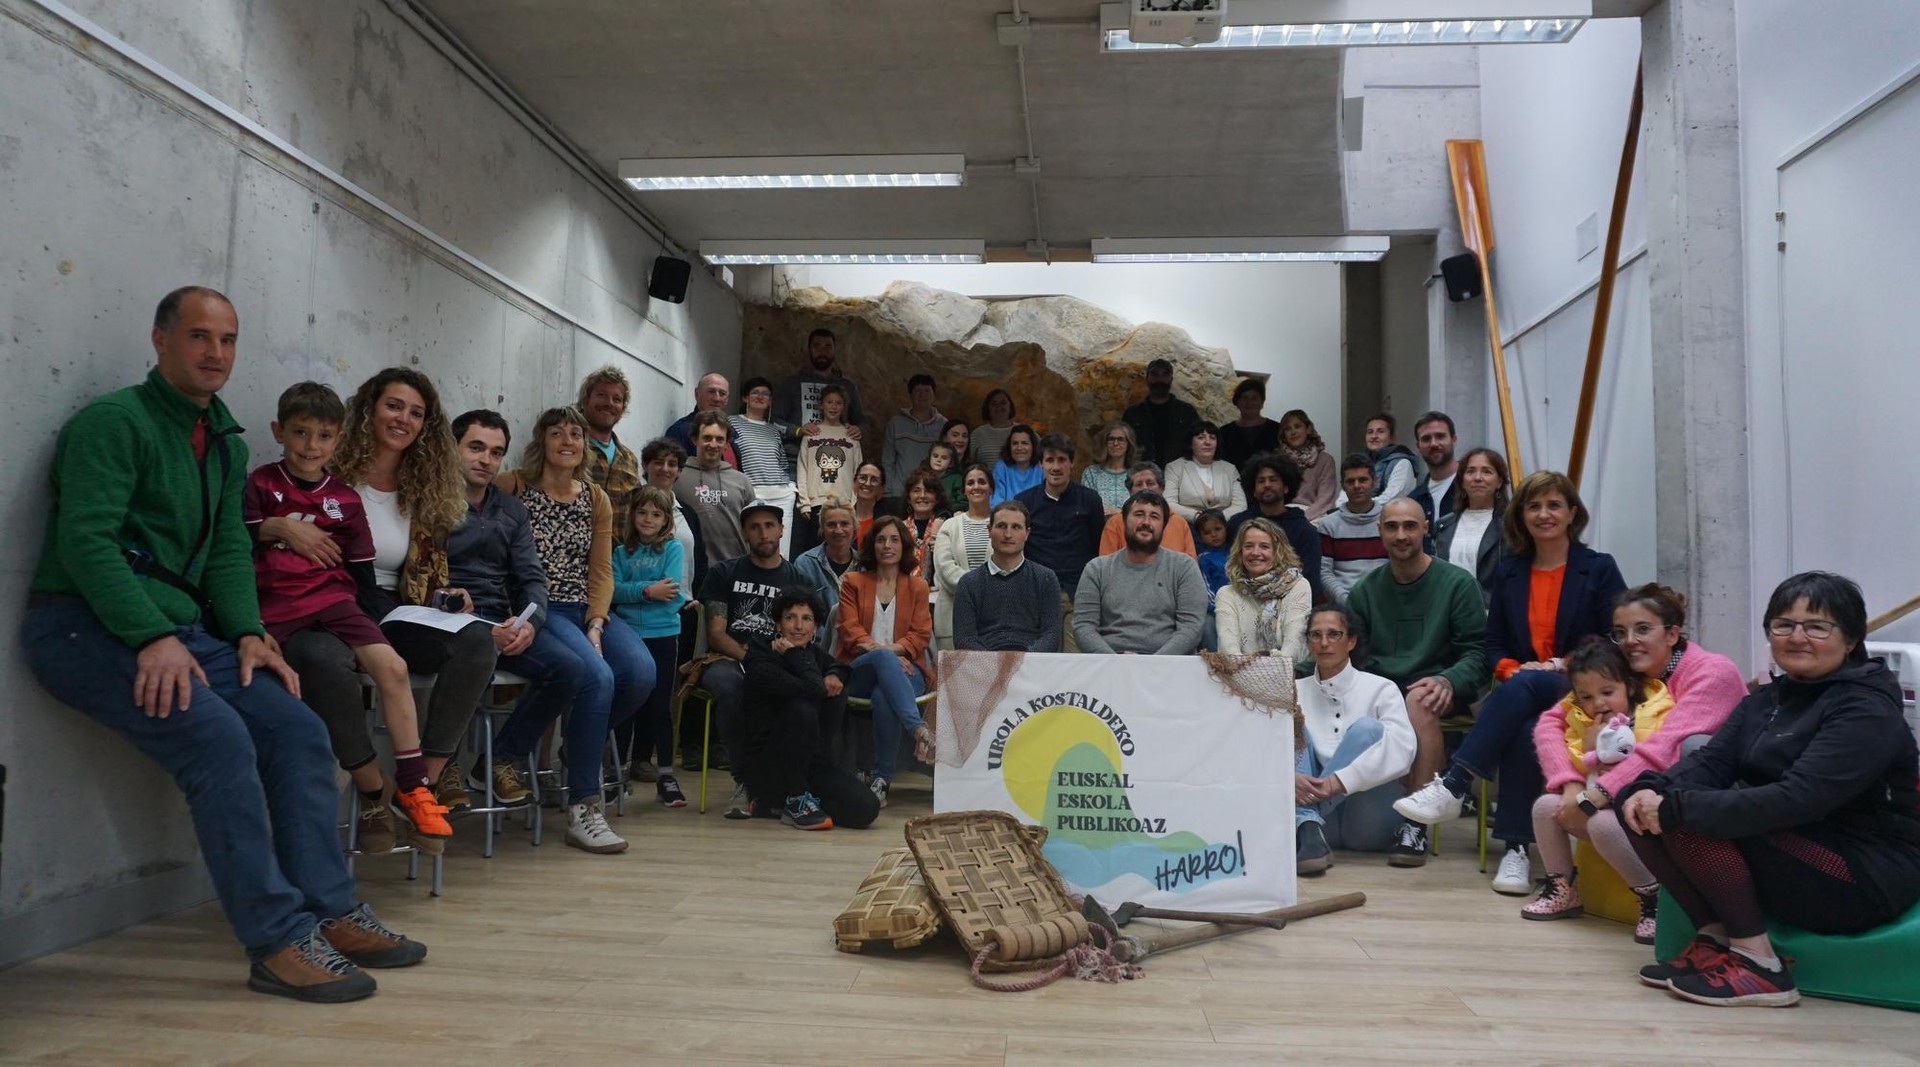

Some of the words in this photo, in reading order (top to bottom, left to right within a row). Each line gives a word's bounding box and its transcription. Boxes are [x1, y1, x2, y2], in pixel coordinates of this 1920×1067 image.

[987, 707, 1030, 771] UROLA
[1027, 691, 1135, 757] KOSTALDEKO
[1057, 771, 1134, 789] EUSKAL
[1057, 794, 1132, 811] ESKOLA
[1056, 815, 1167, 834] PUBLIKOAZ
[1154, 829, 1248, 892] HARRO!
